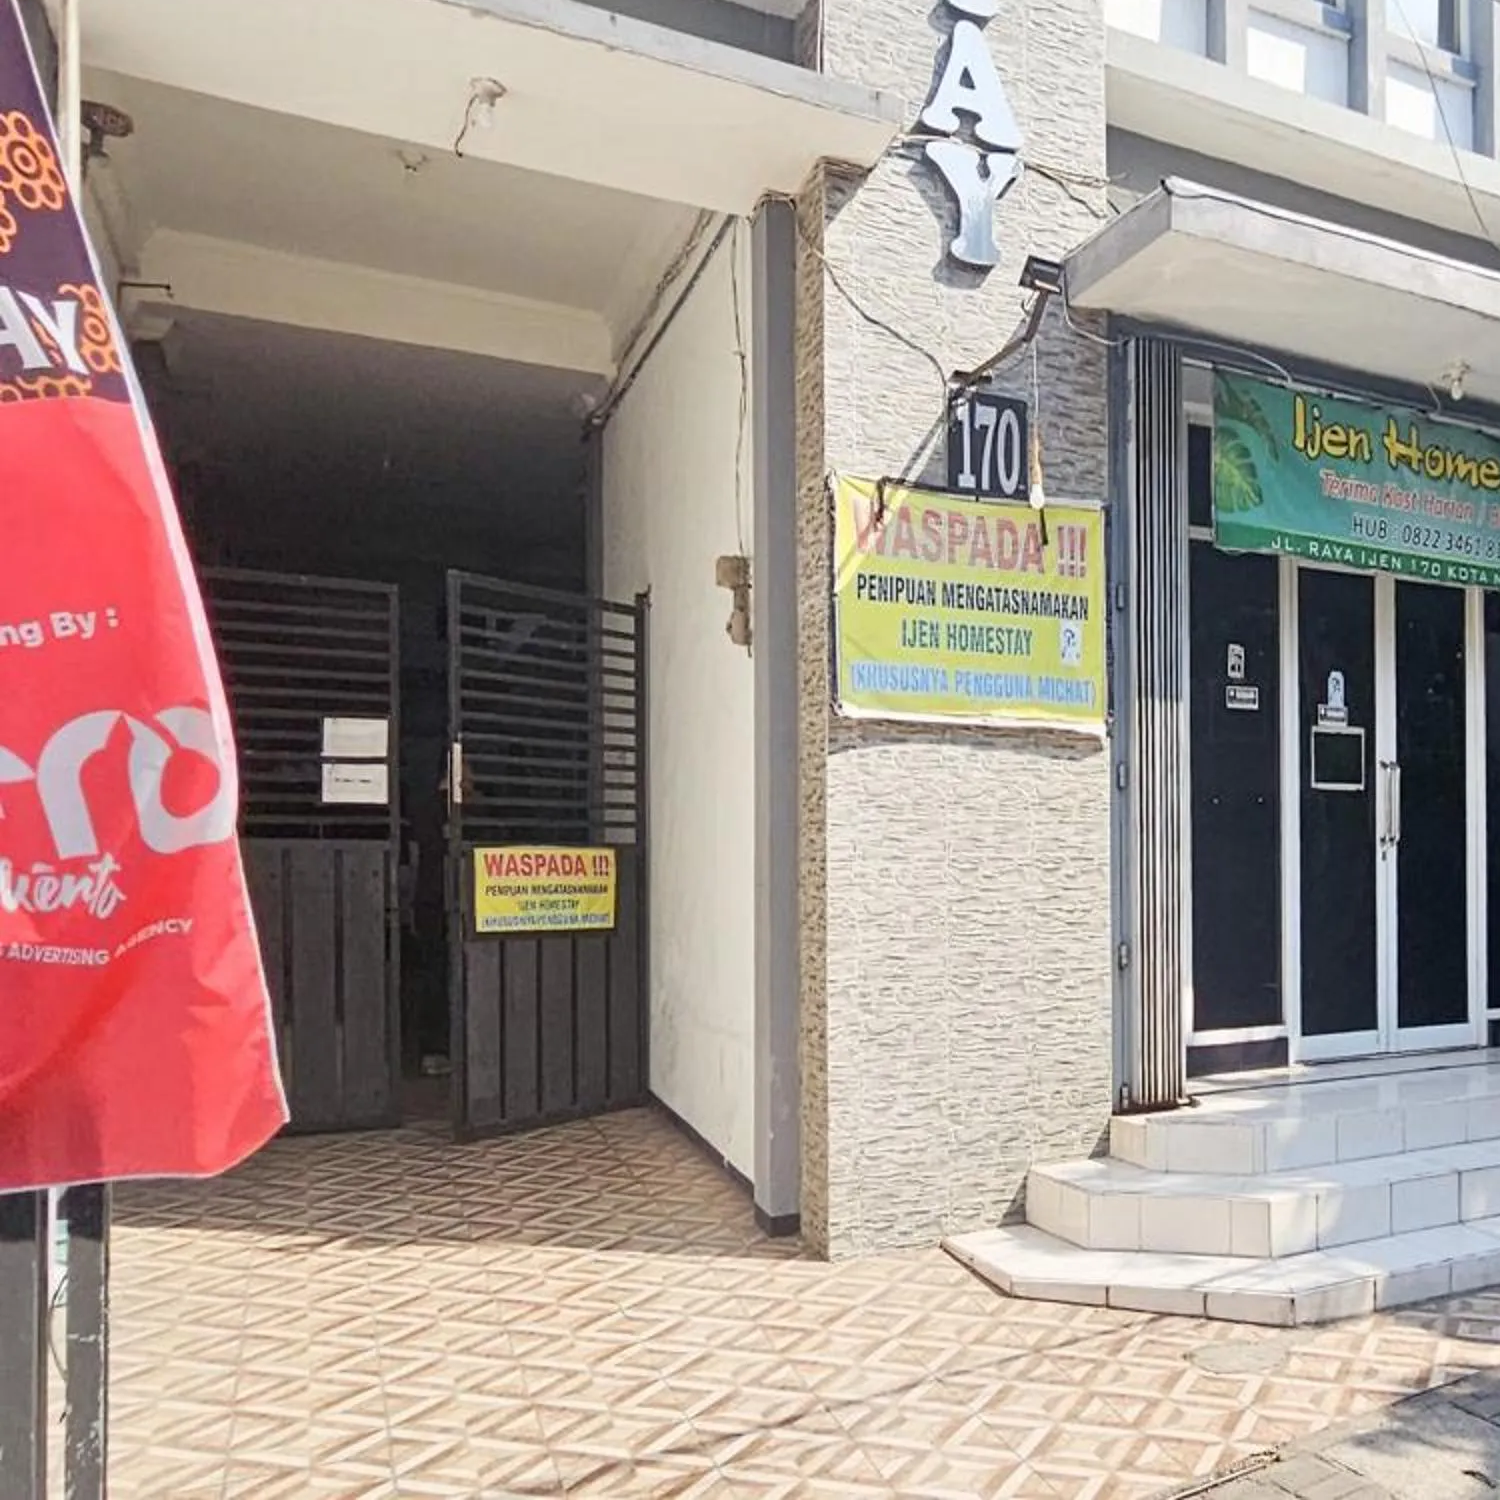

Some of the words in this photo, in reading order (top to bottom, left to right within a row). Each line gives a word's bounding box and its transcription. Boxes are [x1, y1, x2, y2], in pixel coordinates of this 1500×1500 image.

[956, 401, 1021, 495] 170
[1293, 395, 1371, 463] Ijen
[854, 504, 1045, 575] WASPADA
[1353, 515, 1388, 539] HUB
[1402, 525, 1441, 549] 0822
[1310, 542, 1354, 563] RAYA
[1361, 551, 1401, 570] IJEN
[1411, 559, 1441, 577] 170
[1448, 566, 1487, 585] KOTA
[857, 573, 936, 607] PENIPUAN
[942, 582, 1089, 621] MENGATASNAMAKAN
[50, 611, 96, 639] By
[902, 619, 940, 649] IJEN
[947, 624, 1033, 657] HOMESTAY
[955, 670, 1033, 699] PENGGUNA
[484, 853, 586, 877] WASPADA
[592, 855, 609, 877] !!!
